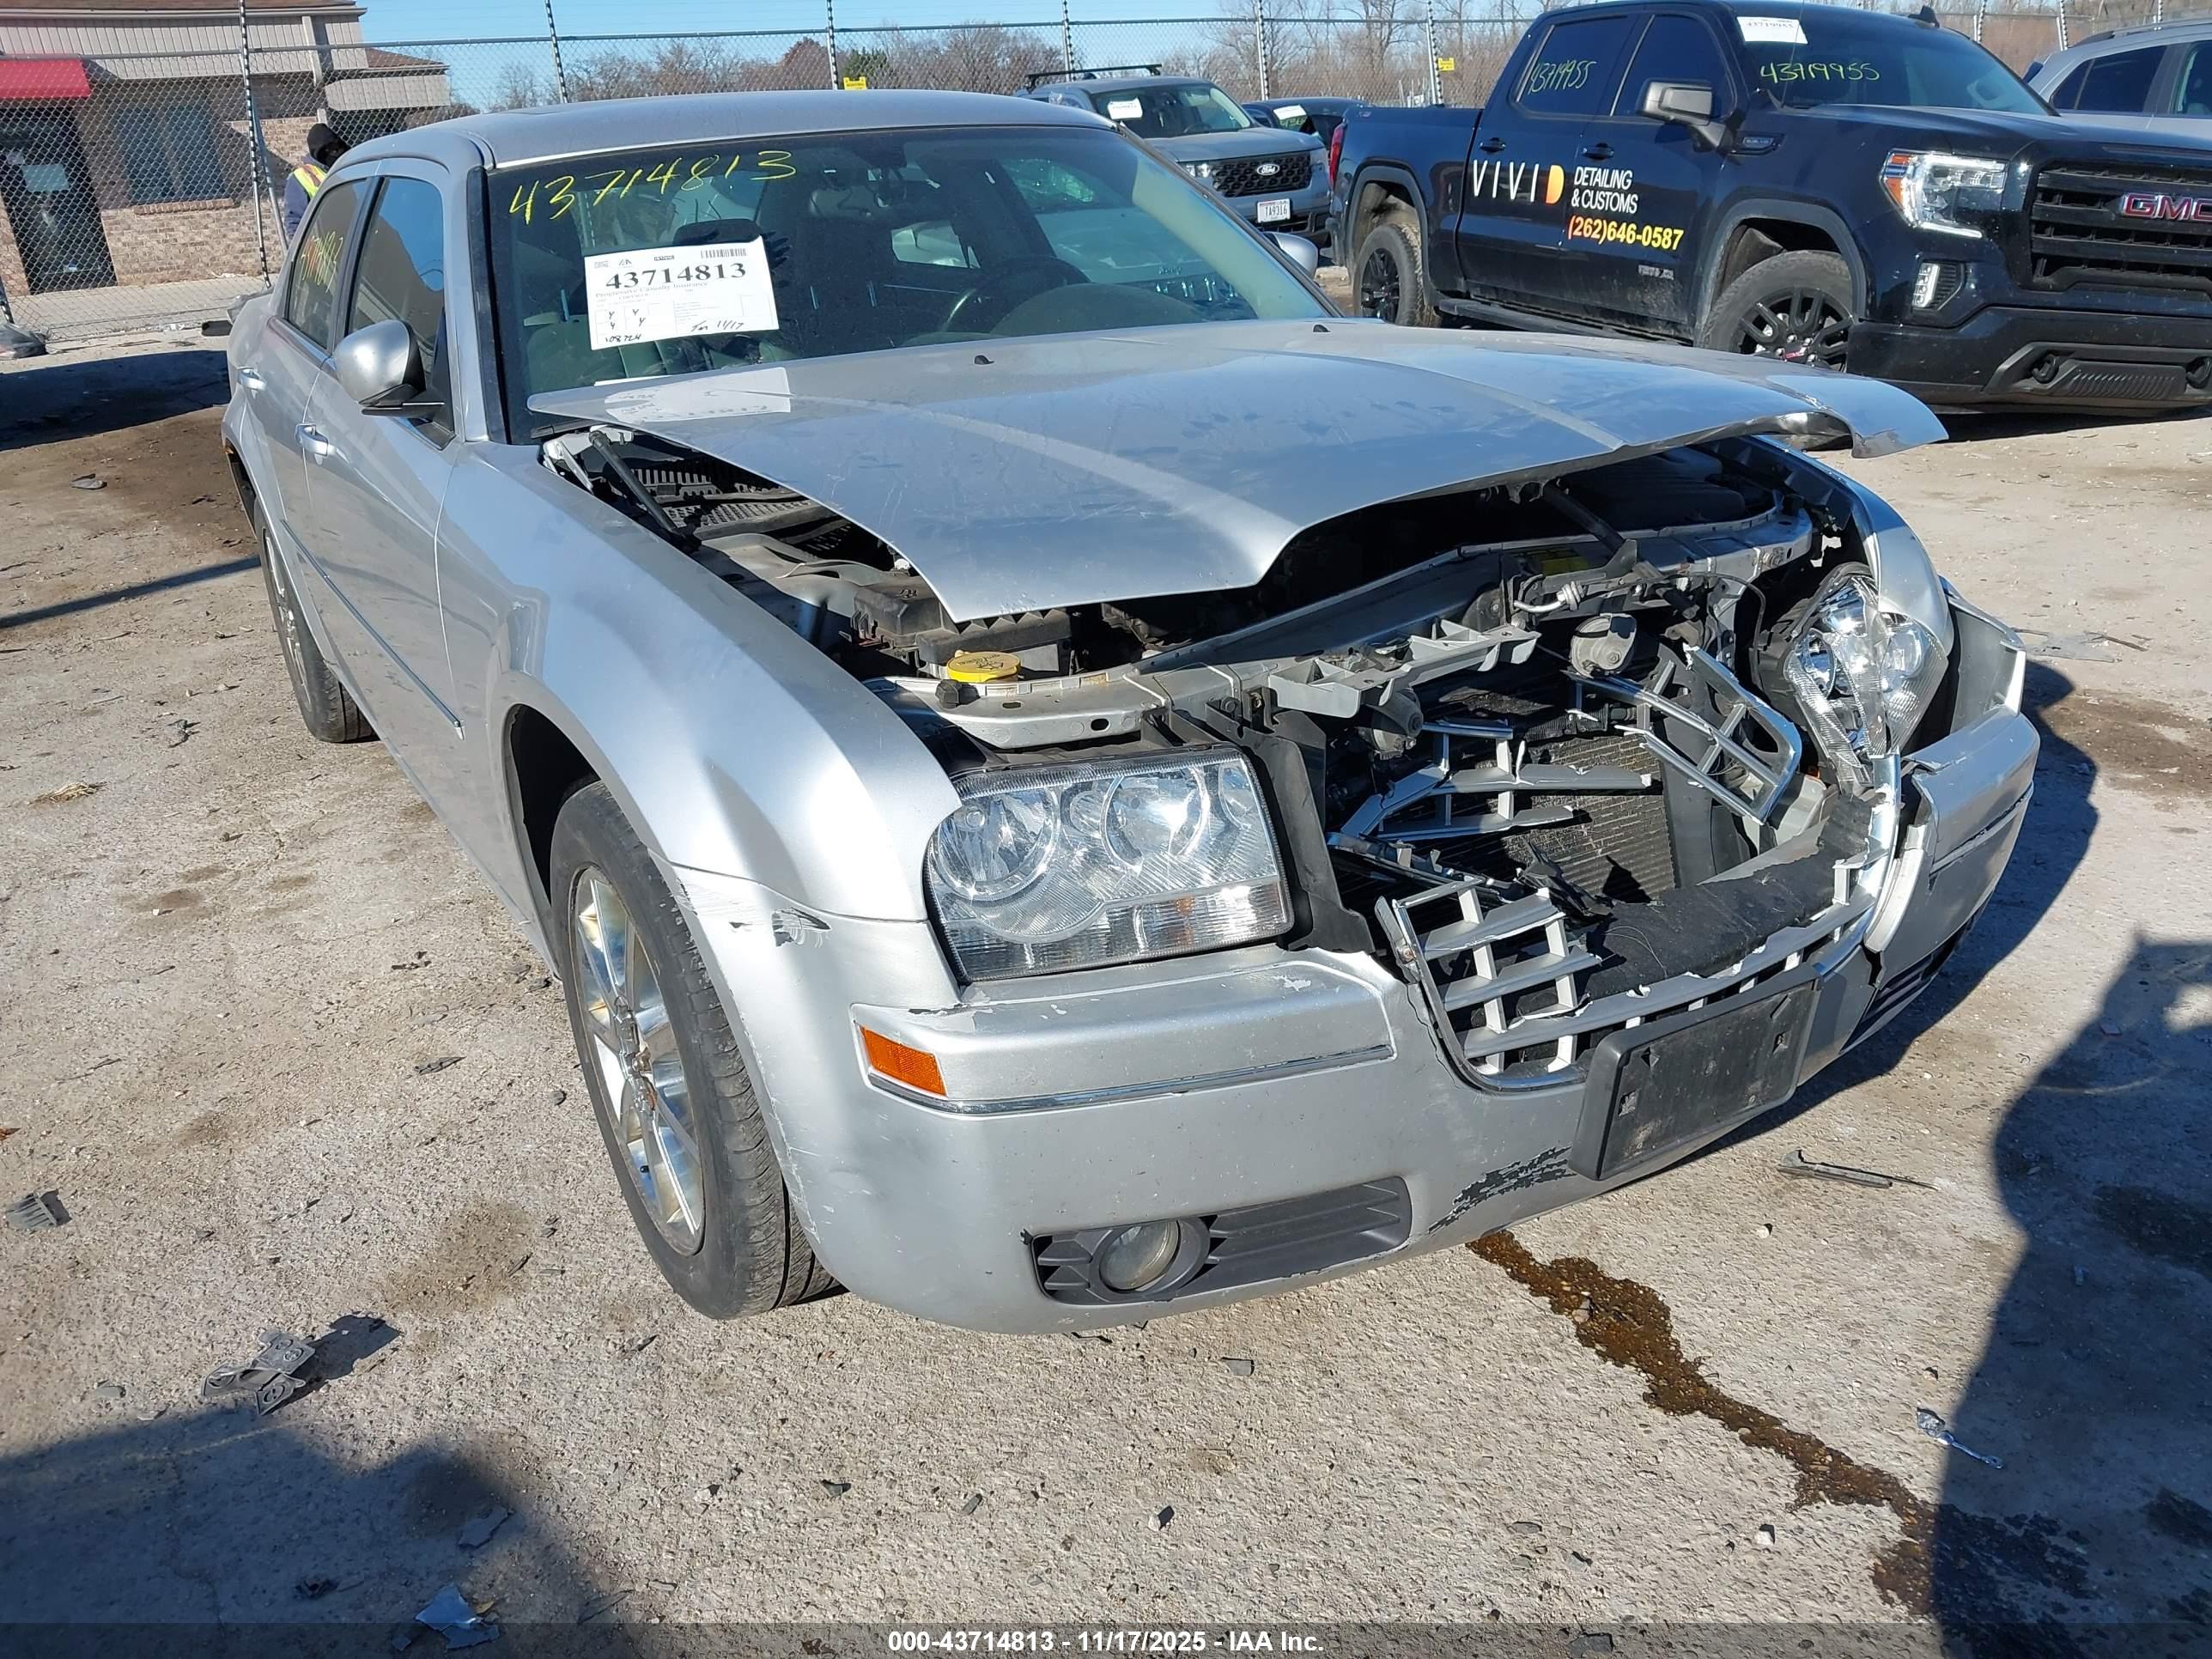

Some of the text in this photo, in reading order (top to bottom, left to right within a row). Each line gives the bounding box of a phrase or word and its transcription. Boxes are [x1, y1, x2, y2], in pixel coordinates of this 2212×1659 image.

[1527, 59, 1598, 95] 43719955
[1760, 62, 1881, 83] 43719955
[508, 149, 797, 225] 43714813
[1473, 159, 1565, 205] VIVID
[1573, 166, 1633, 191] DETAILING
[1571, 190, 1639, 214] & CUSTOMS
[1567, 215, 1685, 251] (262)646-0587
[605, 263, 746, 289] 43714813
